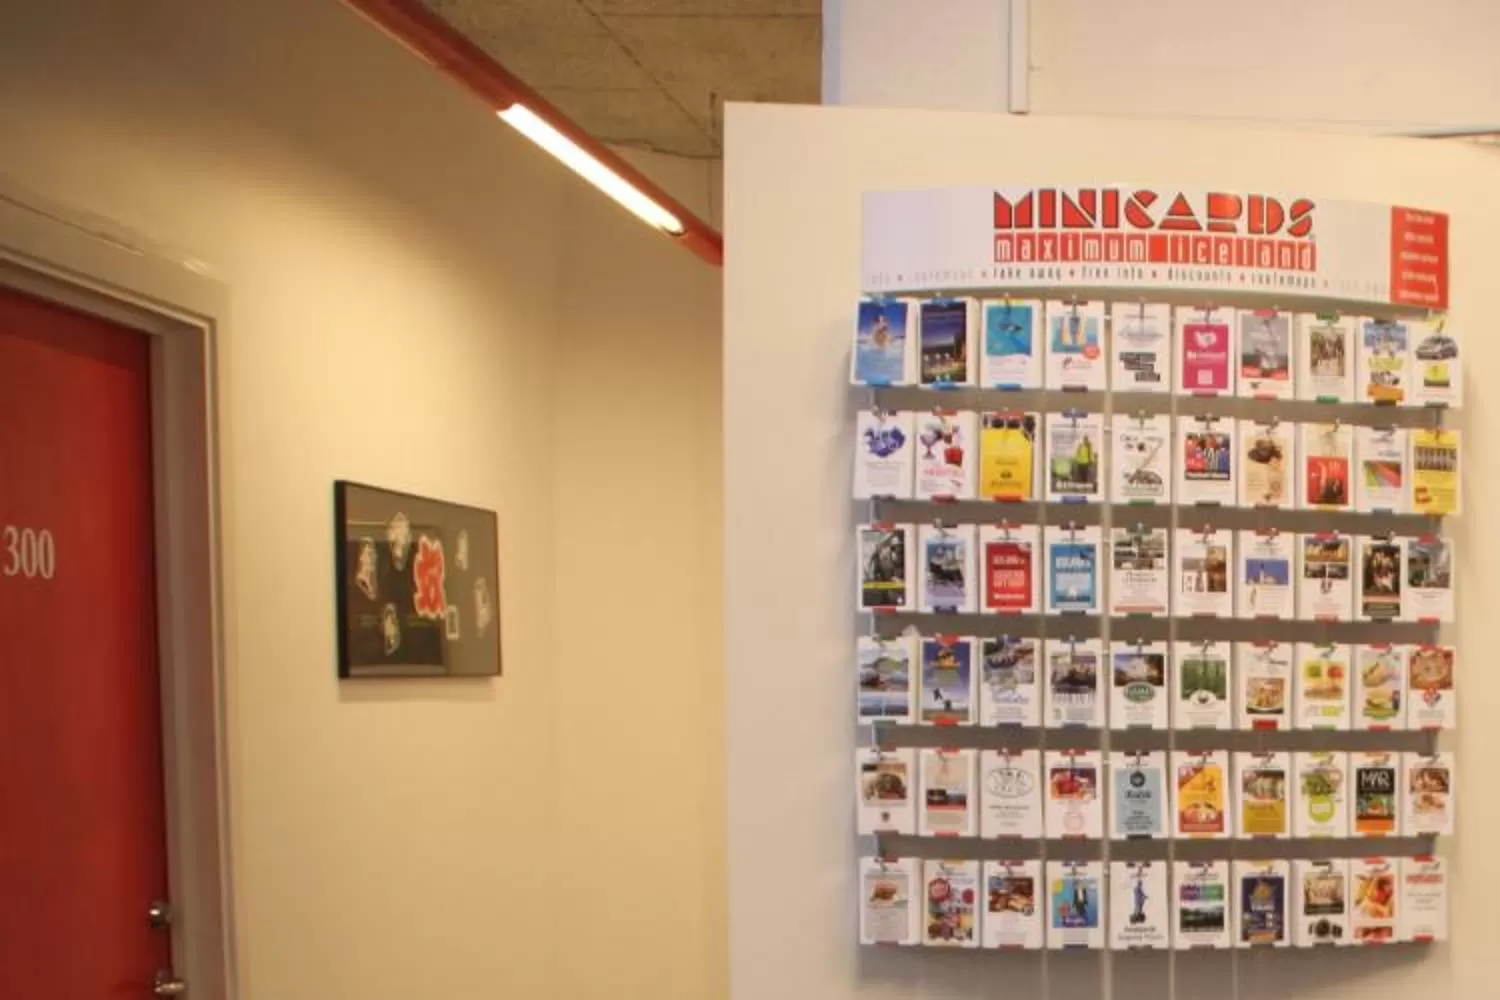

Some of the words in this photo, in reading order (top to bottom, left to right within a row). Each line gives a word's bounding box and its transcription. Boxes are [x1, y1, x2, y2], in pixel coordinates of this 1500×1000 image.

[993, 188, 1316, 238] MINICARDS
[996, 234, 1146, 261] maximum
[1175, 236, 1313, 269] iceland
[3, 524, 55, 580] 300
